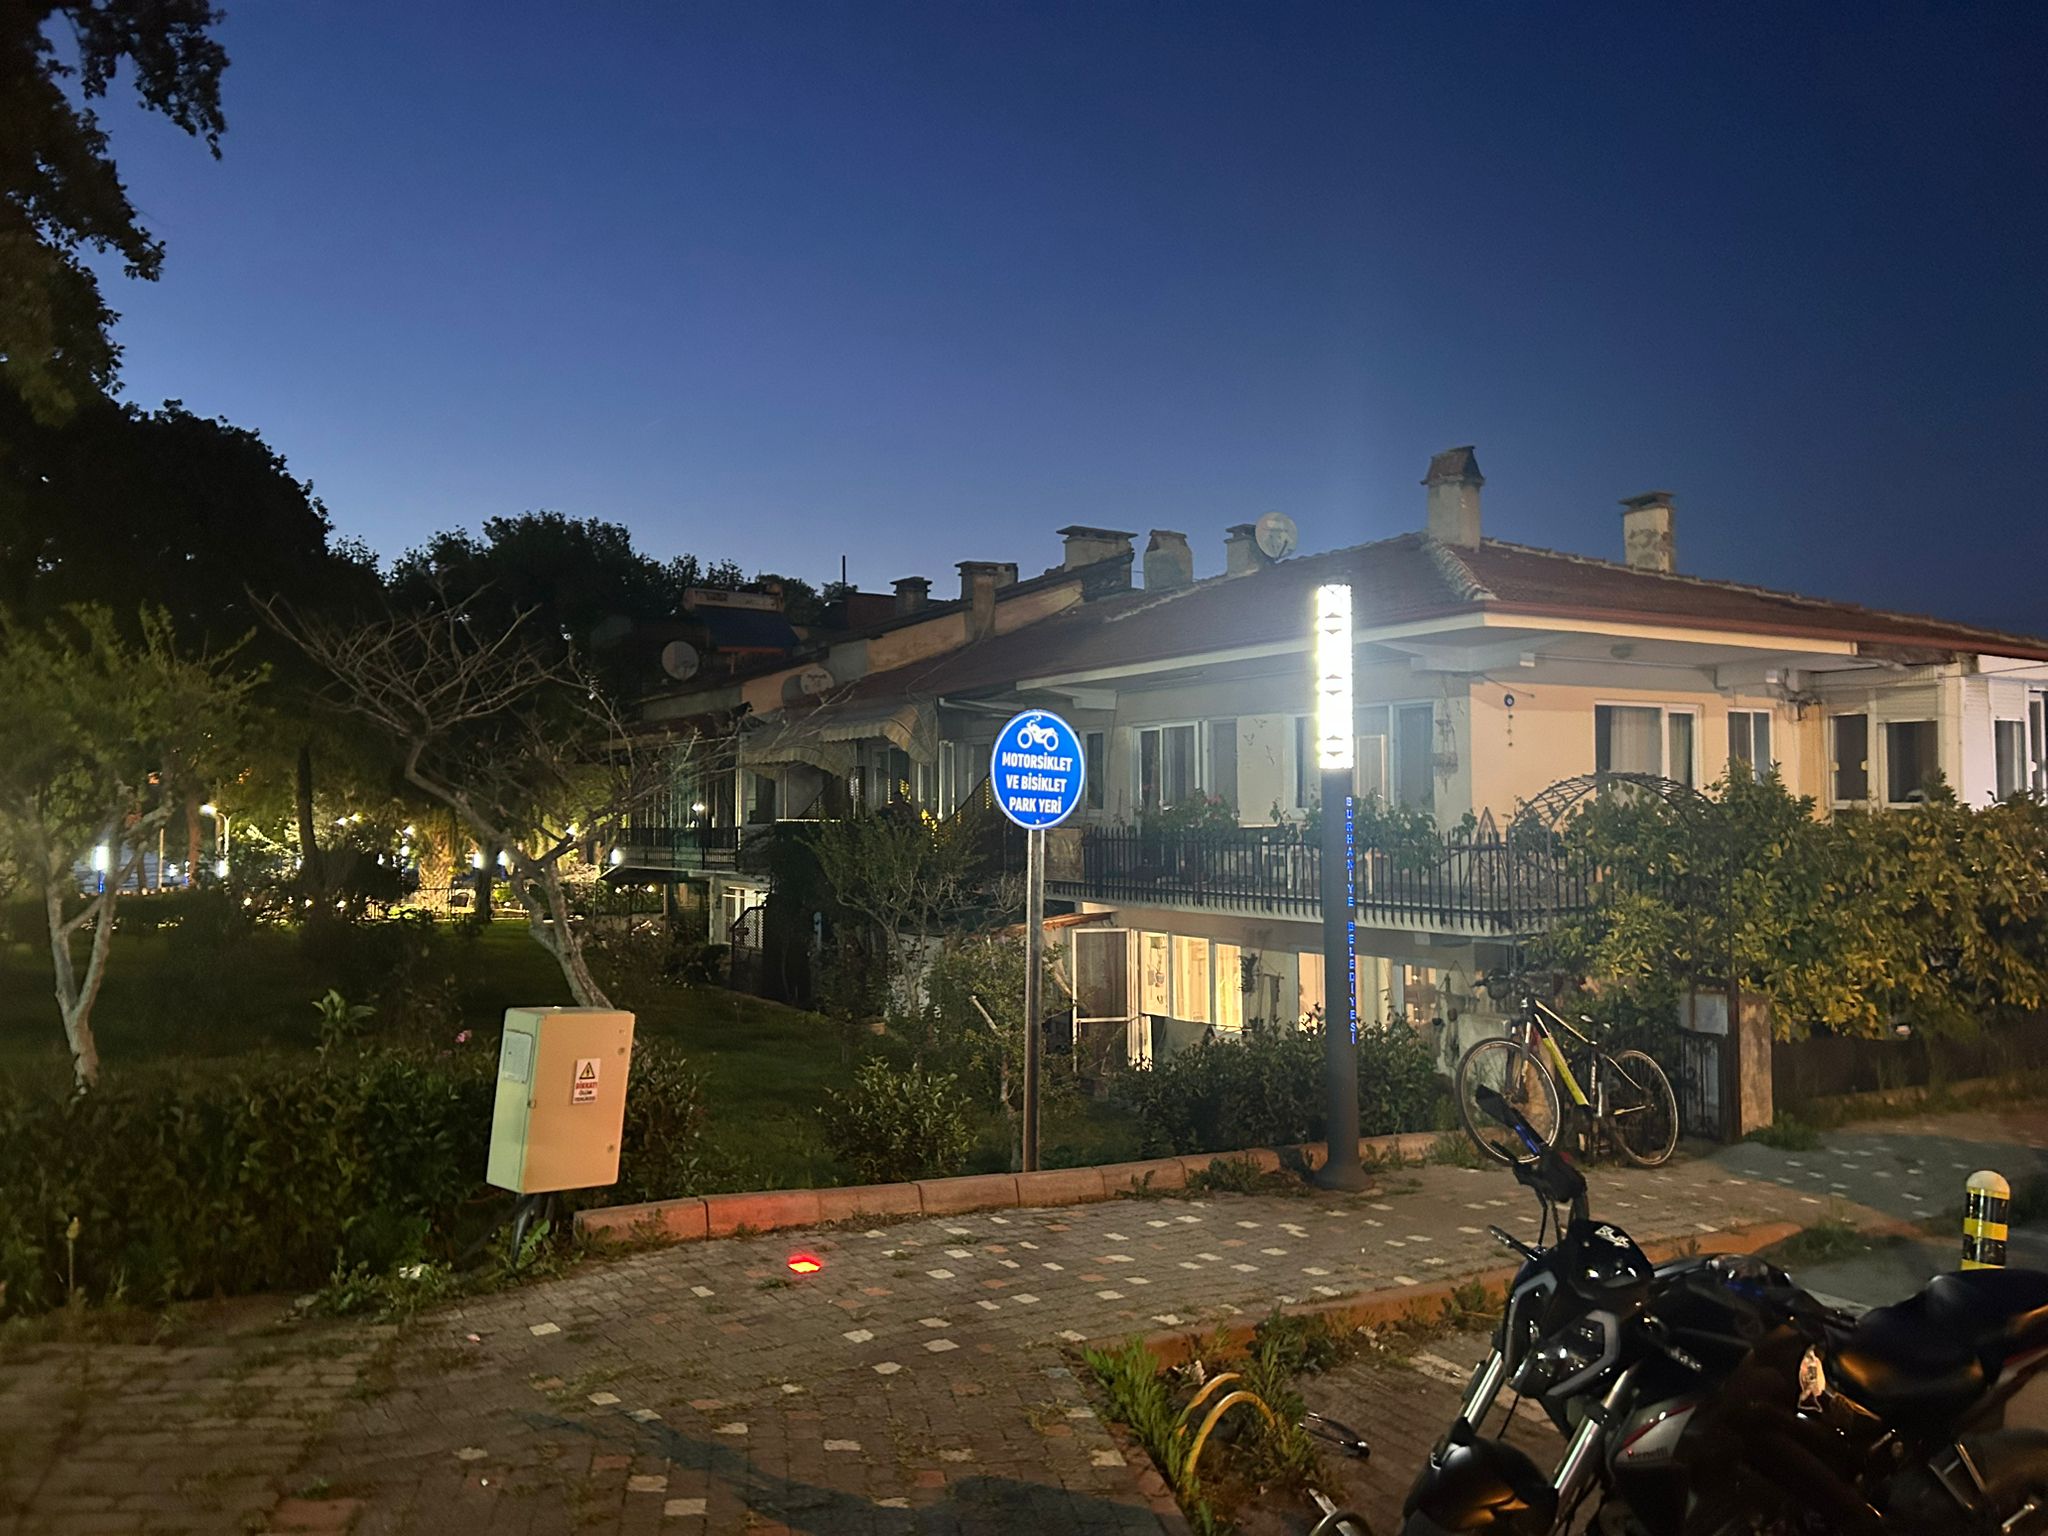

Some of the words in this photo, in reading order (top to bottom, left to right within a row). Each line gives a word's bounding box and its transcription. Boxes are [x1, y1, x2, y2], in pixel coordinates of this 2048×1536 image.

[1002, 752, 1073, 772] MOTORSİKLET
[1006, 774, 1020, 789] VE
[1021, 772, 1068, 793] BİSİKLET
[1009, 796, 1037, 812] PARK
[1038, 796, 1062, 814] YERİ
